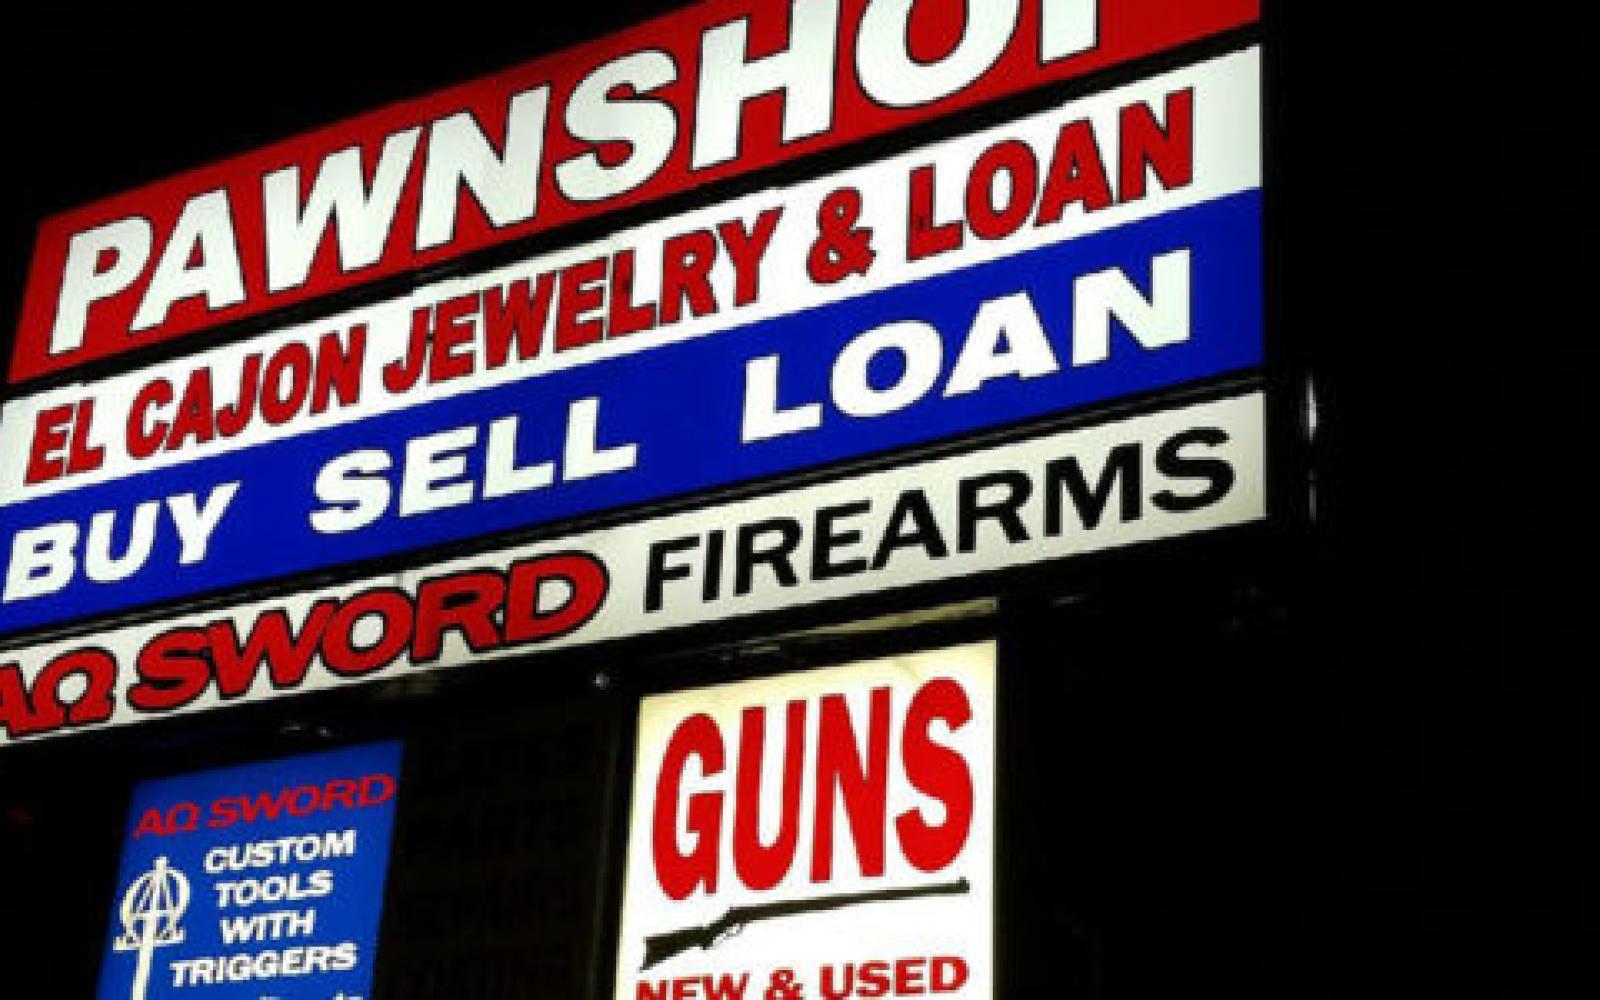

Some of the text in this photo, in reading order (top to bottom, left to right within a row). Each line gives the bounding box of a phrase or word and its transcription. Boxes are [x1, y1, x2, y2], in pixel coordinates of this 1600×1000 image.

[24, 86, 1194, 486] EL CAJON JEWELRY & LOAN
[2, 247, 1193, 602] BUY SELL LOAN
[126, 550, 610, 714] SWORD
[643, 426, 1236, 614] FIREARMS
[206, 773, 397, 829] SWORD
[652, 676, 974, 902] GUNS
[203, 829, 357, 873] CUSTOM
[214, 868, 335, 909] TOOLS
[219, 909, 316, 945] WITH
[169, 943, 358, 988] TRIGGERS
[763, 967, 806, 1000] &
[818, 954, 971, 1000] USED
